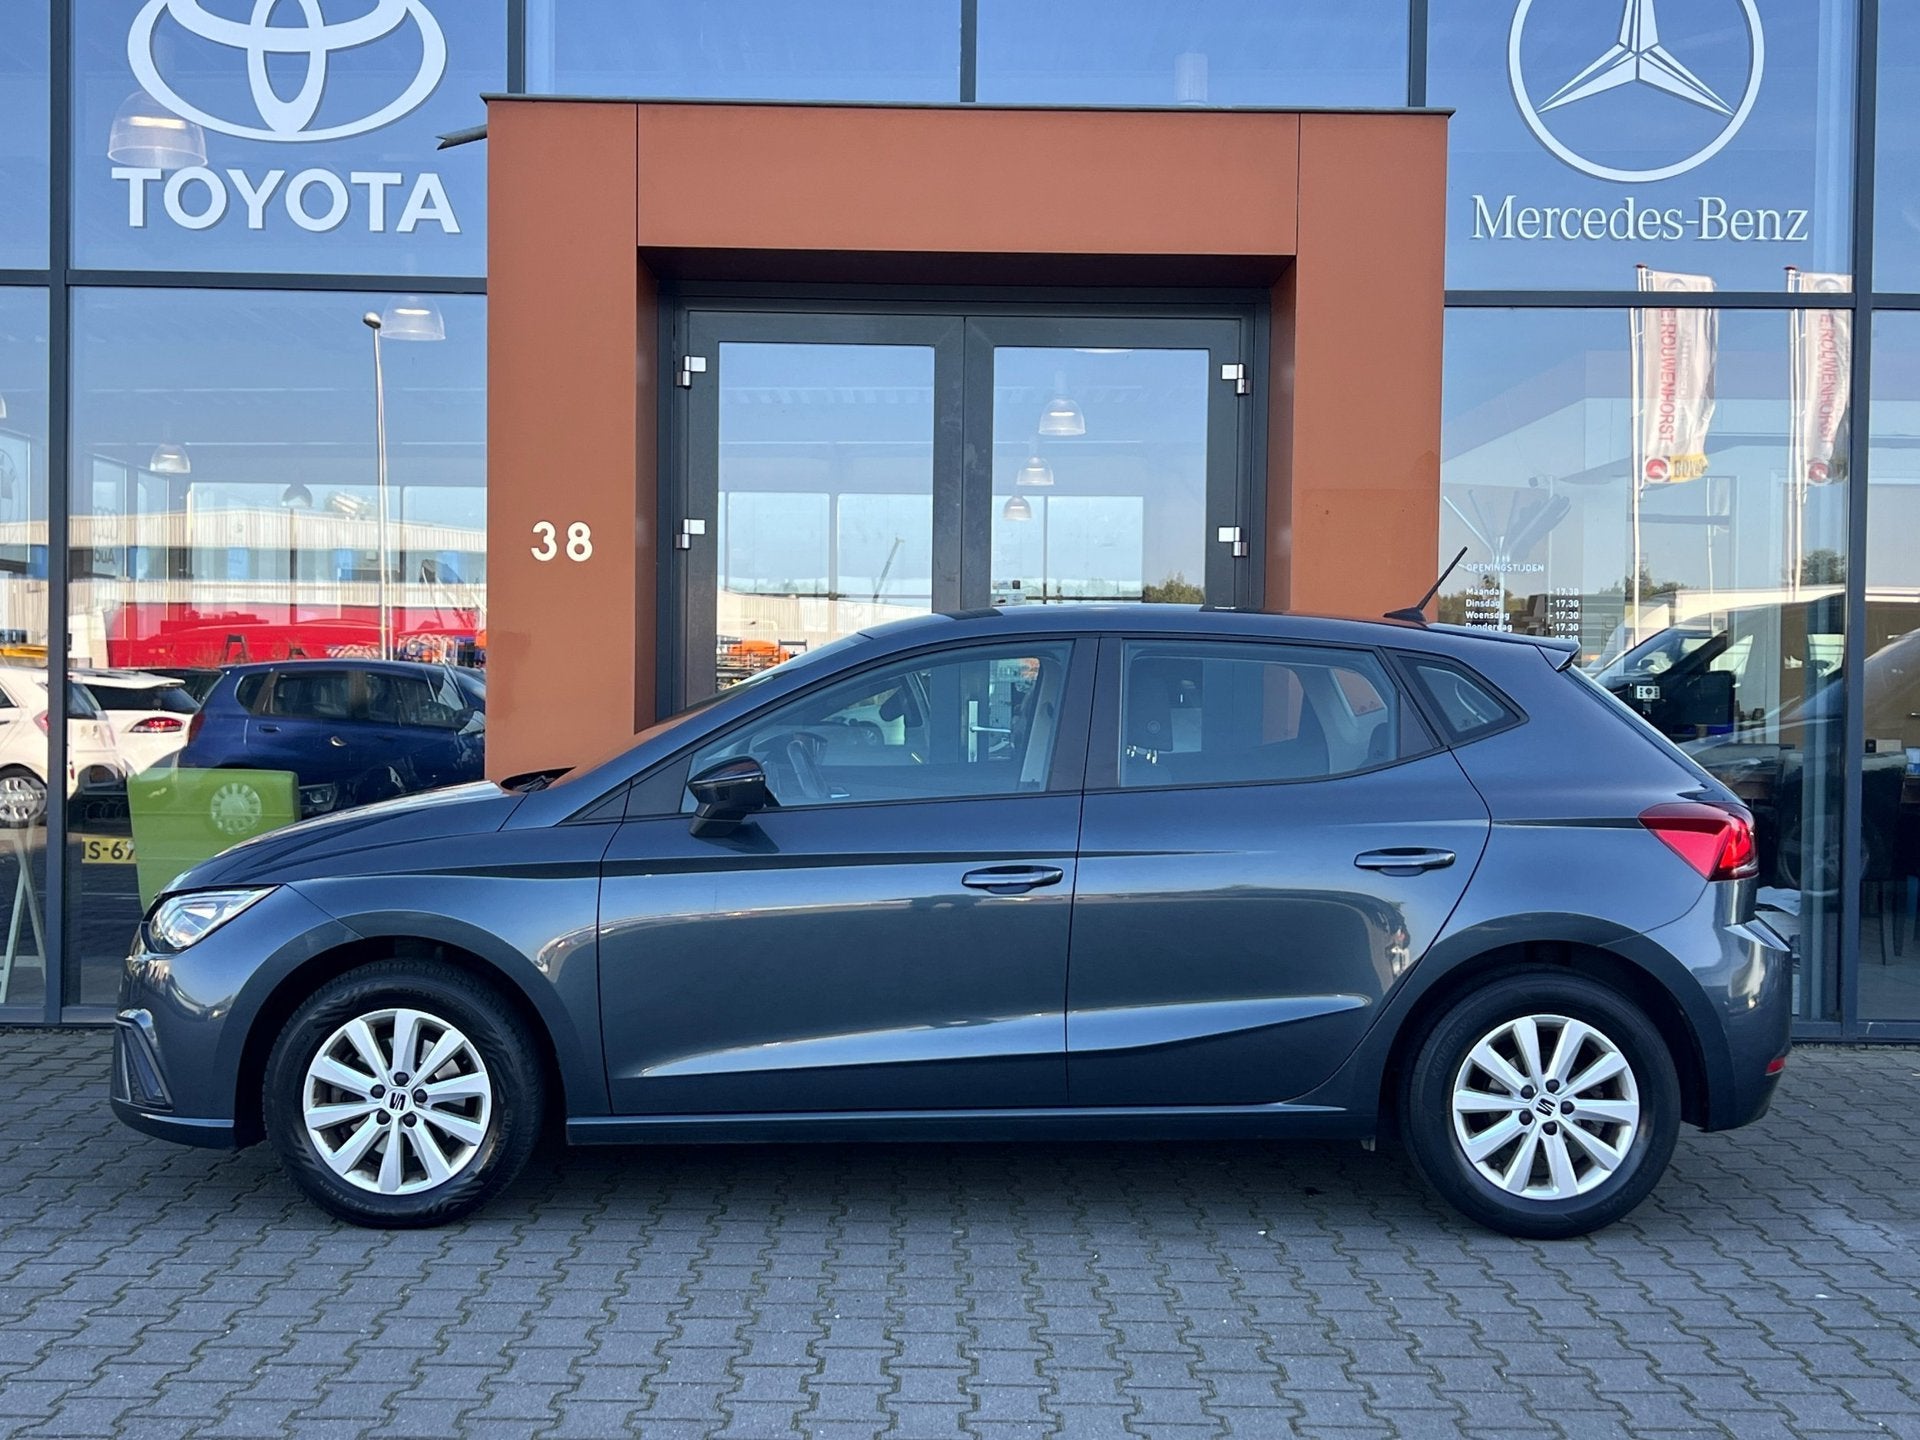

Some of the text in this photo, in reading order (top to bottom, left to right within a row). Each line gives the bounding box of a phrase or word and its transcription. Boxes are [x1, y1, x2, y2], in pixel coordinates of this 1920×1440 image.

[111, 167, 463, 234] TOYOTA
[1471, 194, 1809, 242] Mercedes-Benz
[530, 521, 594, 562] 38
[1466, 563, 1544, 573] OPENINGSTIJDEN
[1556, 588, 1579, 596] 17.30
[1465, 599, 1502, 609] Dinsdag
[1555, 600, 1579, 608] 17.30
[1465, 611, 1510, 621] Woensdag
[1555, 611, 1579, 620] 17.30
[1555, 623, 1579, 632] 17.30
